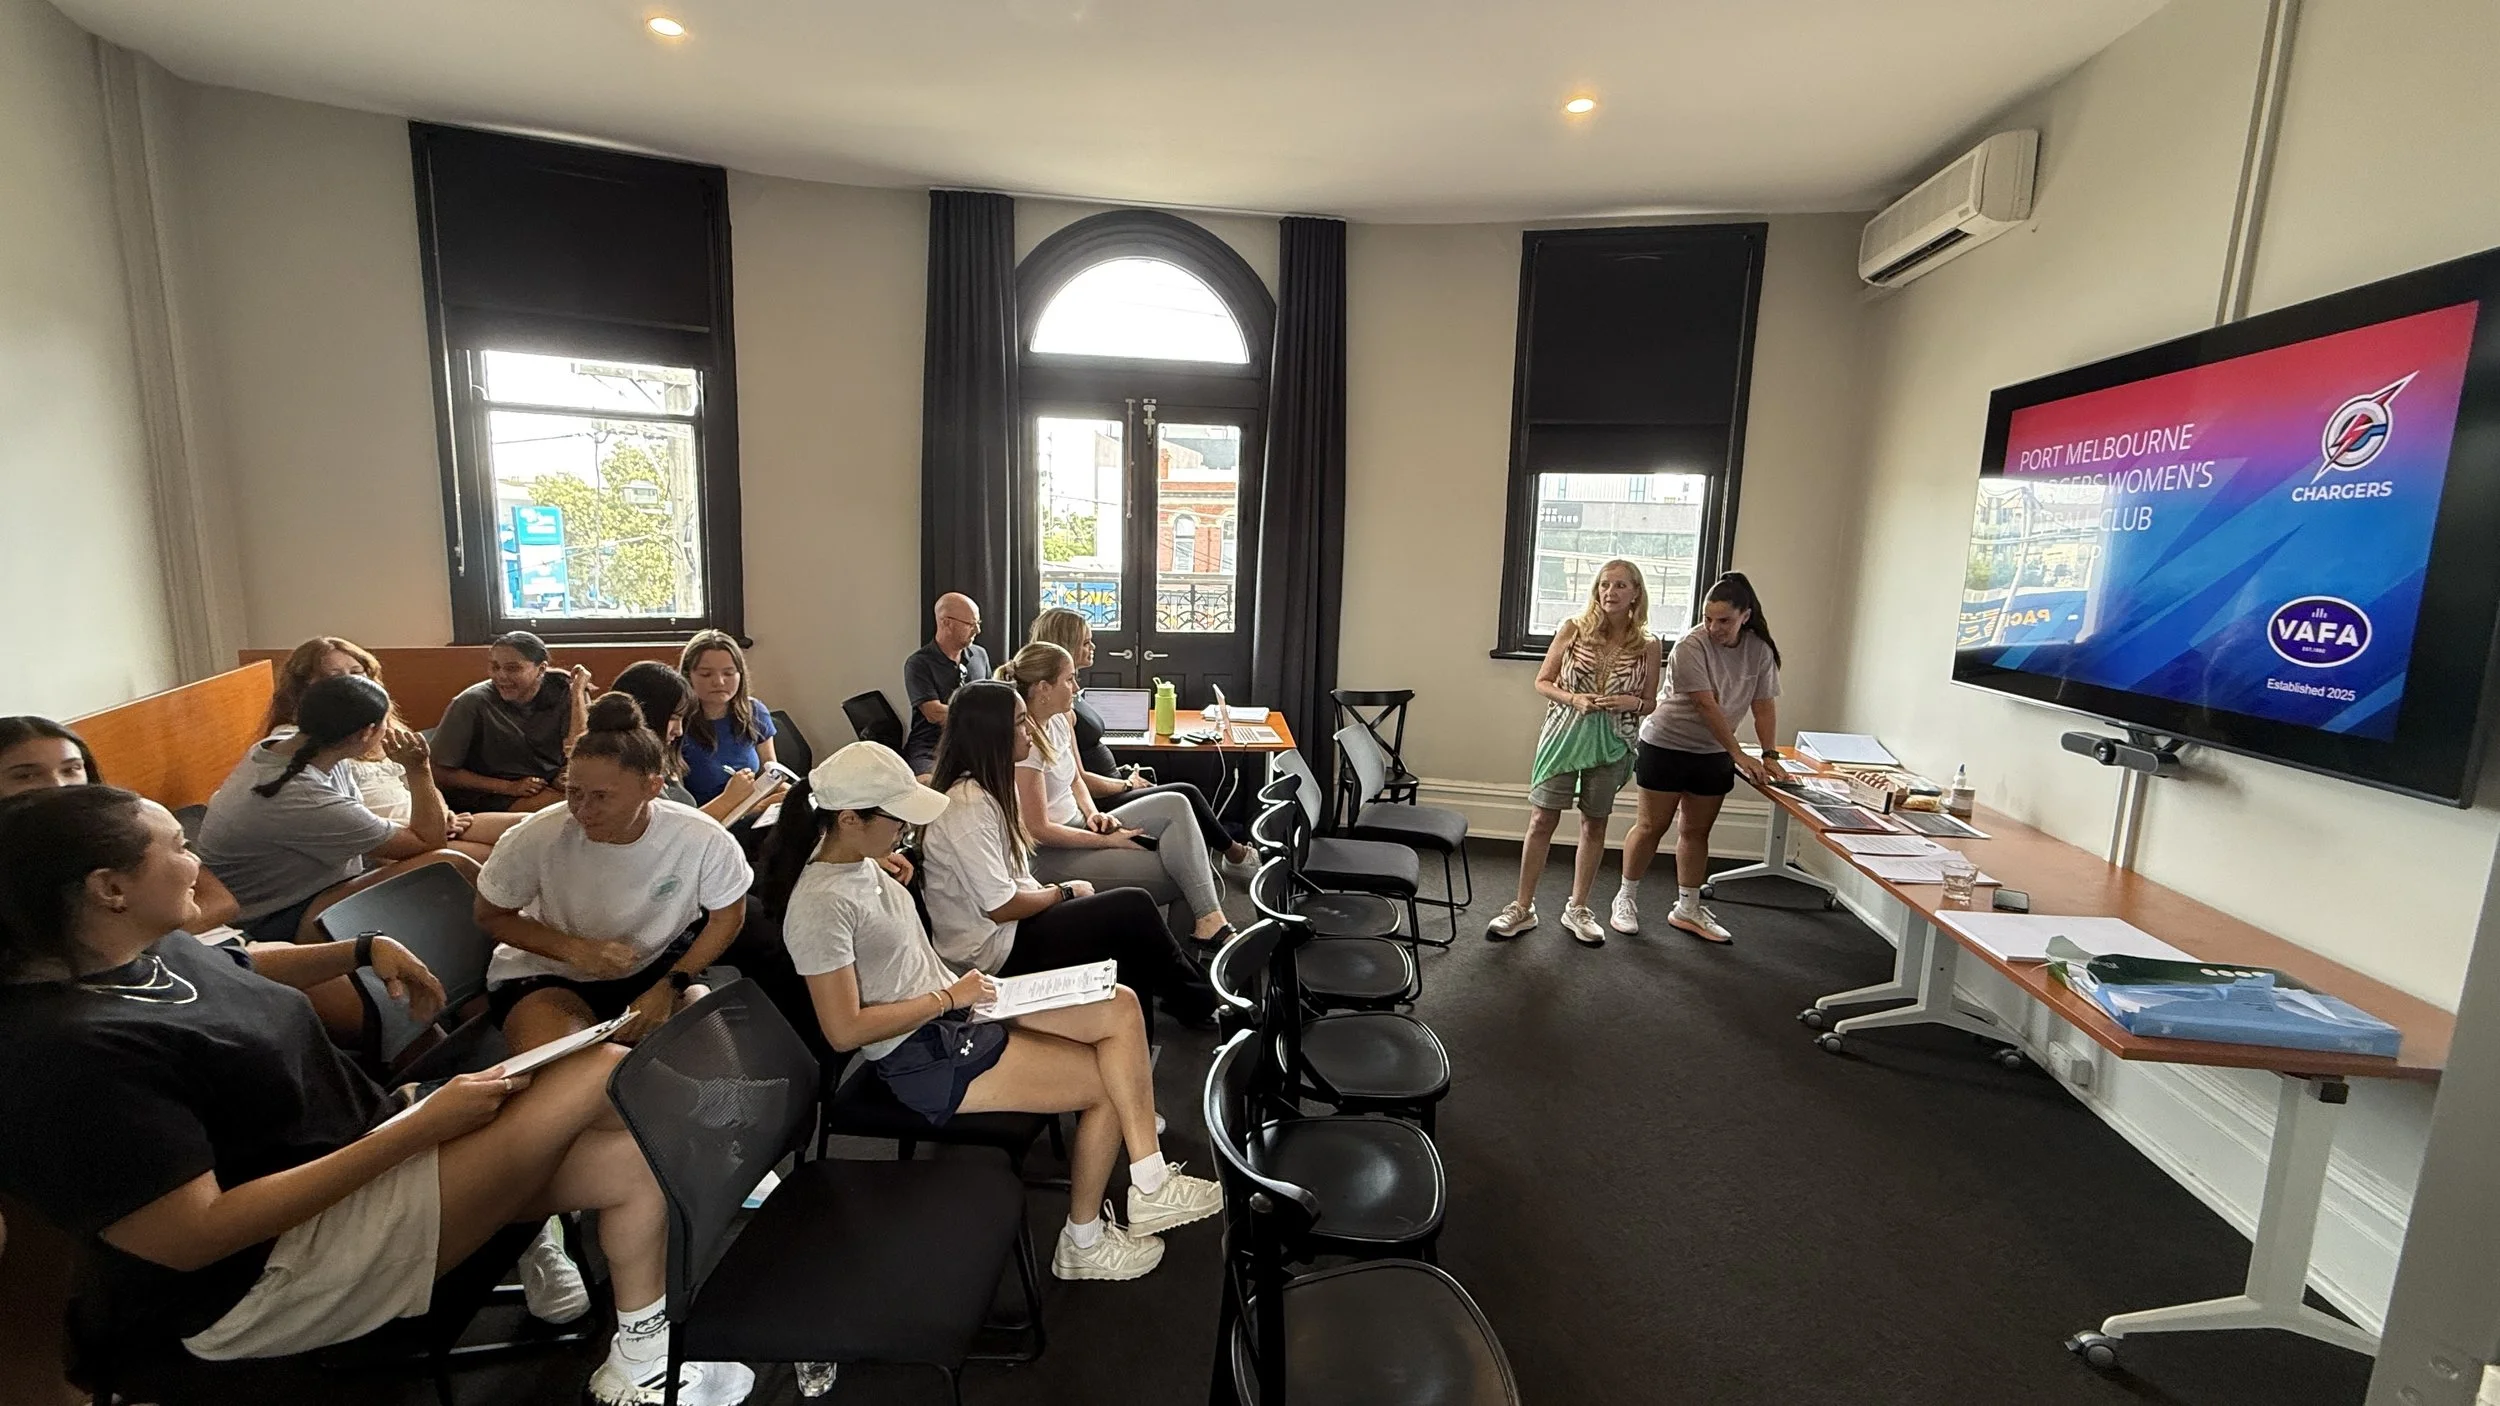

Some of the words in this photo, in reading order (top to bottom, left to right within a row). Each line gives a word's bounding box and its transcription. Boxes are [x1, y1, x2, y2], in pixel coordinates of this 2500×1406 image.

[2019, 445, 2063, 472] PORT
[2065, 423, 2195, 466] MELBOURNE
[2107, 461, 2216, 495] WOMEN'S
[2291, 481, 2394, 502] CHARGERS
[2100, 506, 2153, 532] CLUB
[2277, 618, 2360, 647] VAFA
[2267, 678, 2326, 697] Established
[2326, 687, 2357, 702] 2025
